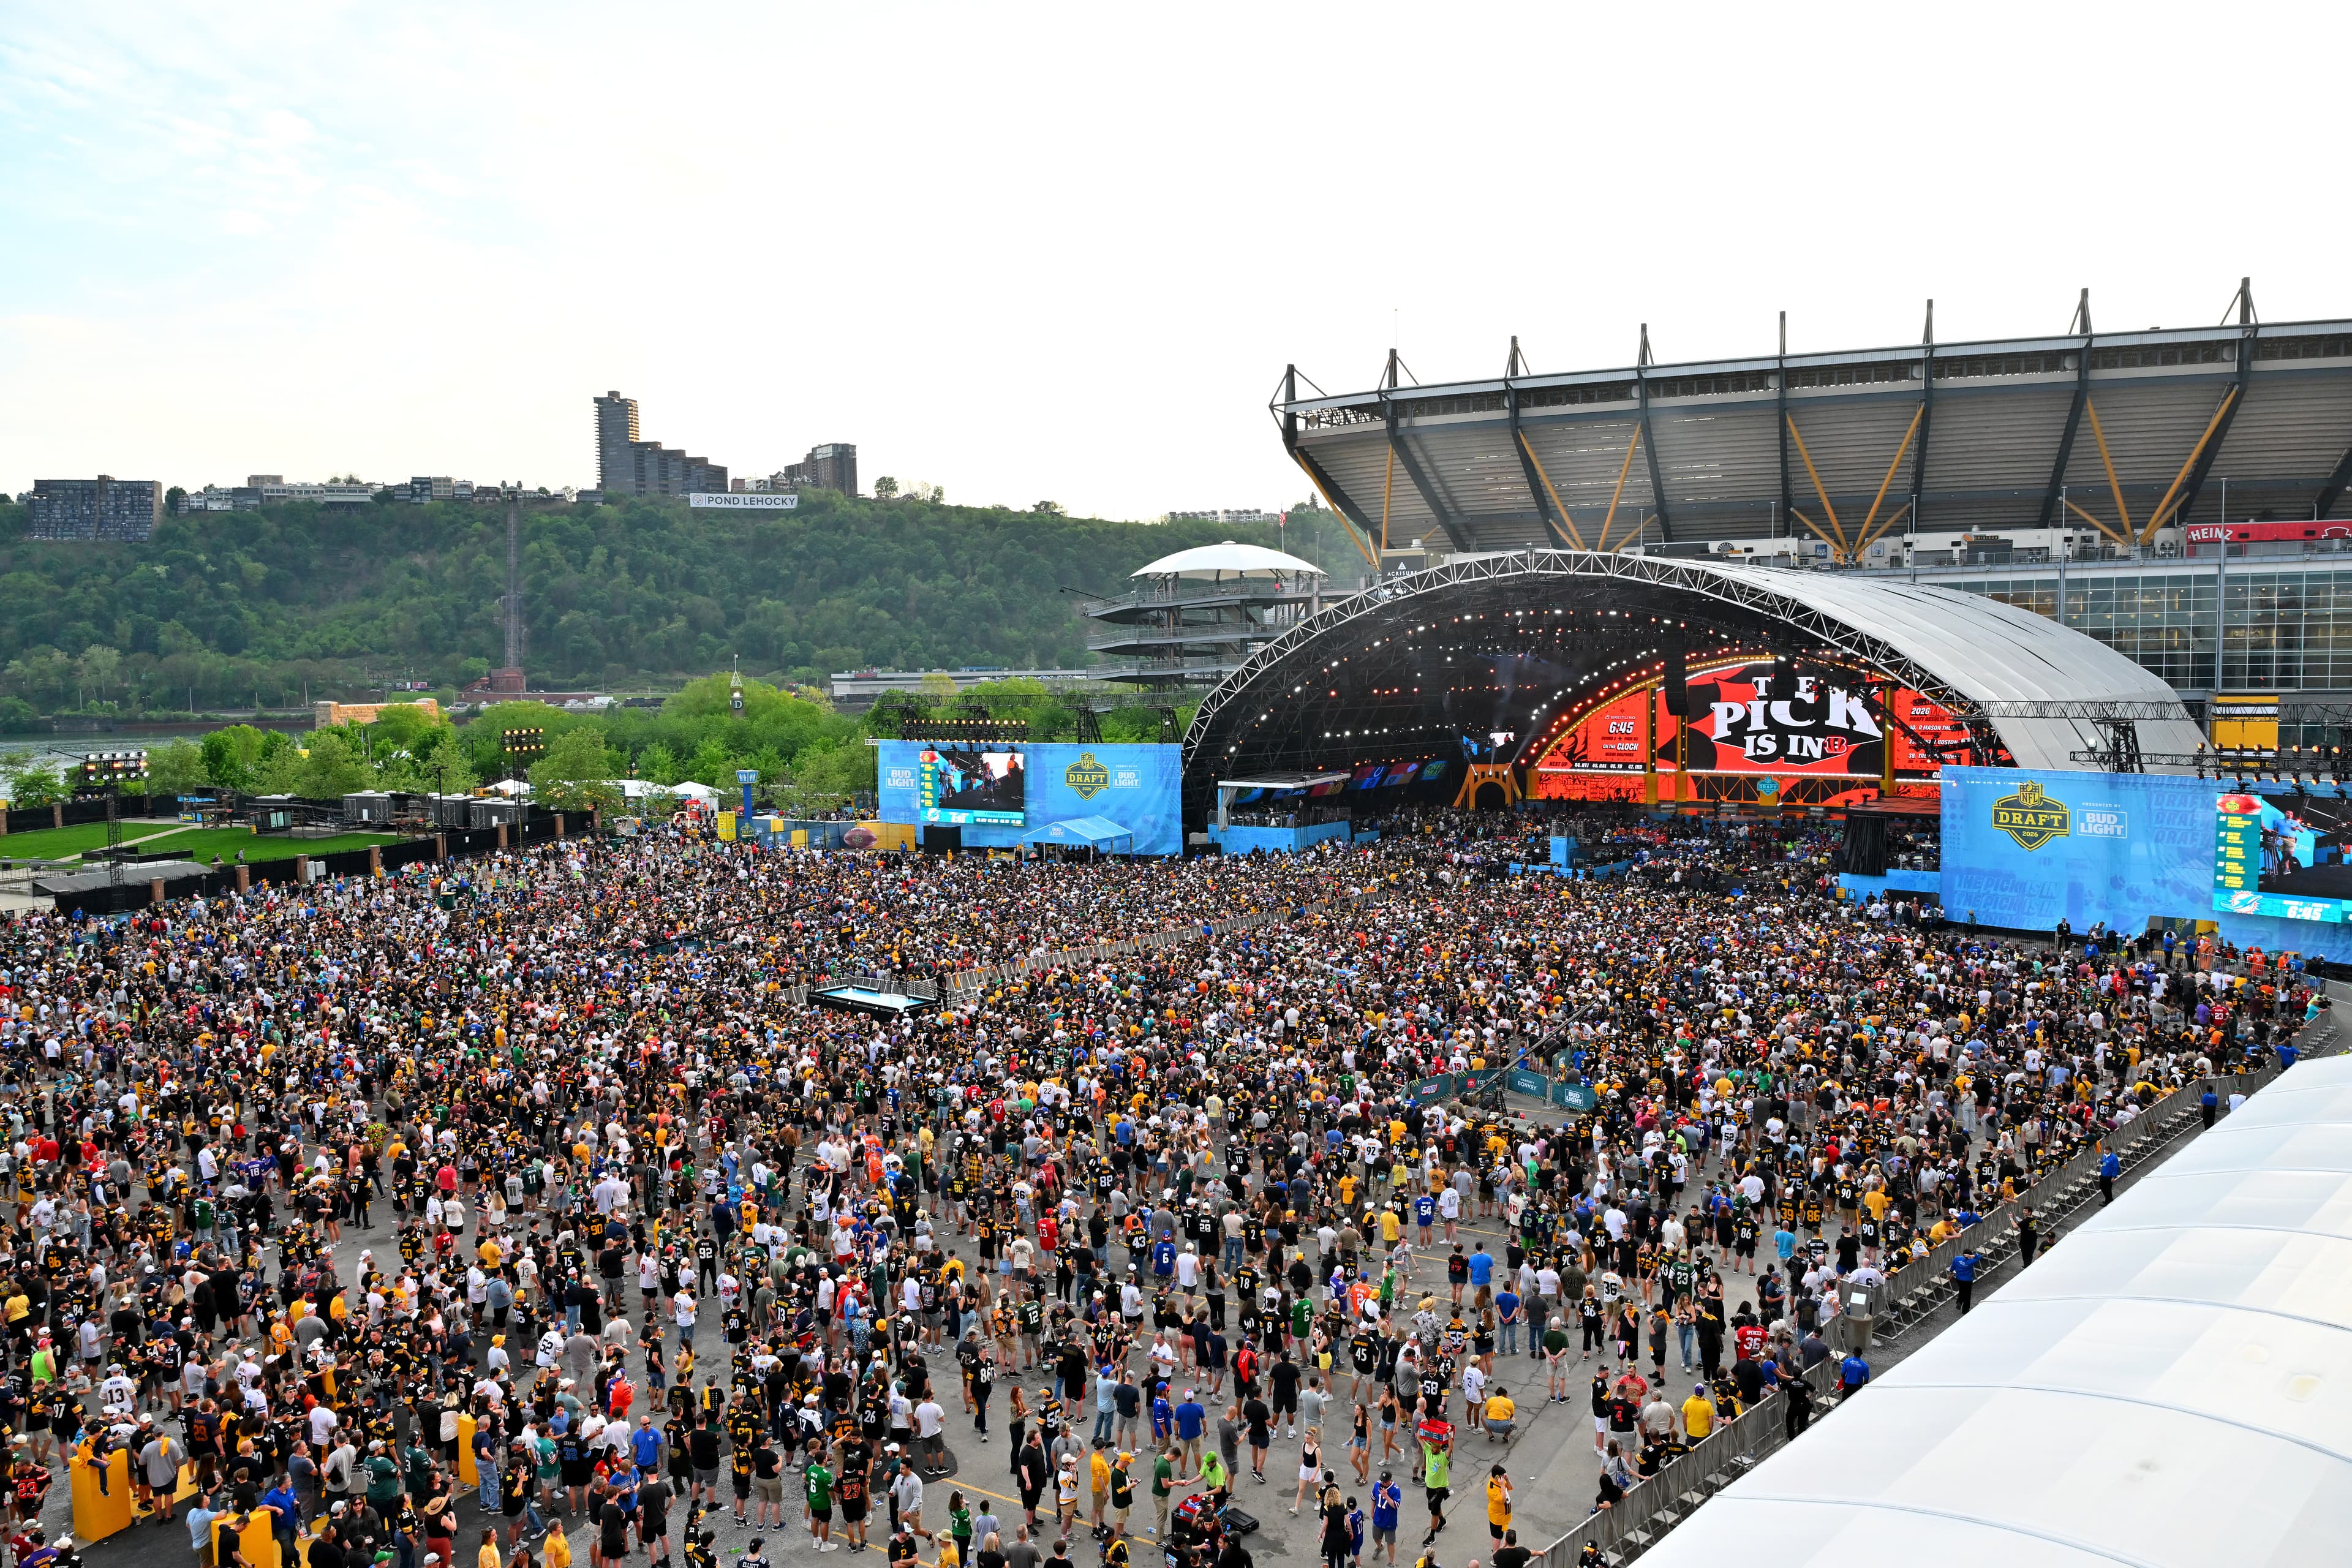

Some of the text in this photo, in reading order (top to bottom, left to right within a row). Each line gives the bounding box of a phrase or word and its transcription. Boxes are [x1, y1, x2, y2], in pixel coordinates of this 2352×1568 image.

[708, 497, 739, 505] POND
[2190, 527, 2233, 541] HEINZ
[1752, 677, 1815, 696] TE
[1711, 686, 1883, 739] PICK
[1609, 722, 1634, 734] 6:45
[1744, 734, 1777, 757] IS
[1787, 735, 1825, 759] IN
[891, 770, 911, 778] BUD
[1069, 774, 1105, 783] DRAFT
[888, 778, 914, 787] LIGHT
[2021, 793, 2038, 803] NFL
[1999, 812, 2062, 827] DRAFT
[2086, 813, 2117, 824] BUD
[2080, 823, 2124, 835] LIGHT
[2287, 905, 2323, 921] 6:45
[1422, 1085, 1437, 1093] SNICKERS
[1518, 1080, 1537, 1090] BONVOY
[1724, 1133, 1735, 1141] 52
[1366, 1147, 1375, 1156] 92
[1446, 1143, 1454, 1152] 10
[1661, 1170, 1666, 1180] 5
[351, 1183, 358, 1194] 97
[1789, 1178, 1803, 1189] 75
[415, 1186, 424, 1197] 35
[1841, 1188, 1851, 1198] 90
[1393, 1202, 1401, 1212] 90
[1420, 1206, 1431, 1216] 54
[1781, 1208, 1794, 1221] 39
[1807, 1210, 1820, 1221] 86
[590, 1223, 603, 1235] 90
[1039, 1228, 1047, 1237] 13
[1199, 1223, 1211, 1232] 28
[1251, 1229, 1256, 1240] 2
[1740, 1228, 1751, 1239] 86
[1133, 1236, 1146, 1248] 43
[1595, 1236, 1605, 1248] 36
[698, 1248, 712, 1258] 92
[1163, 1253, 1169, 1264] 6
[48, 1255, 61, 1268] 86
[1240, 1277, 1250, 1288] 18
[1677, 1272, 1689, 1284] 23
[1604, 1282, 1618, 1294] 36
[1028, 1313, 1039, 1324] 12
[1304, 1311, 1309, 1321] 6
[1267, 1321, 1272, 1333] 8
[1096, 1332, 1107, 1343] 43
[1449, 1331, 1463, 1344] 58
[539, 1342, 552, 1354] 52
[1745, 1337, 1761, 1350] 36
[1355, 1348, 1368, 1361] 45
[459, 1383, 466, 1398] 9
[1423, 1381, 1438, 1395] 58
[108, 1388, 123, 1403] 13
[53, 1403, 66, 1418] 97
[864, 1410, 876, 1423] 26
[1047, 1410, 1059, 1428] 58
[564, 1447, 578, 1461] 32
[17, 1483, 37, 1499] 23
[810, 1480, 816, 1493] 6
[842, 1484, 861, 1499] 23
[900, 1548, 907, 1559] P
